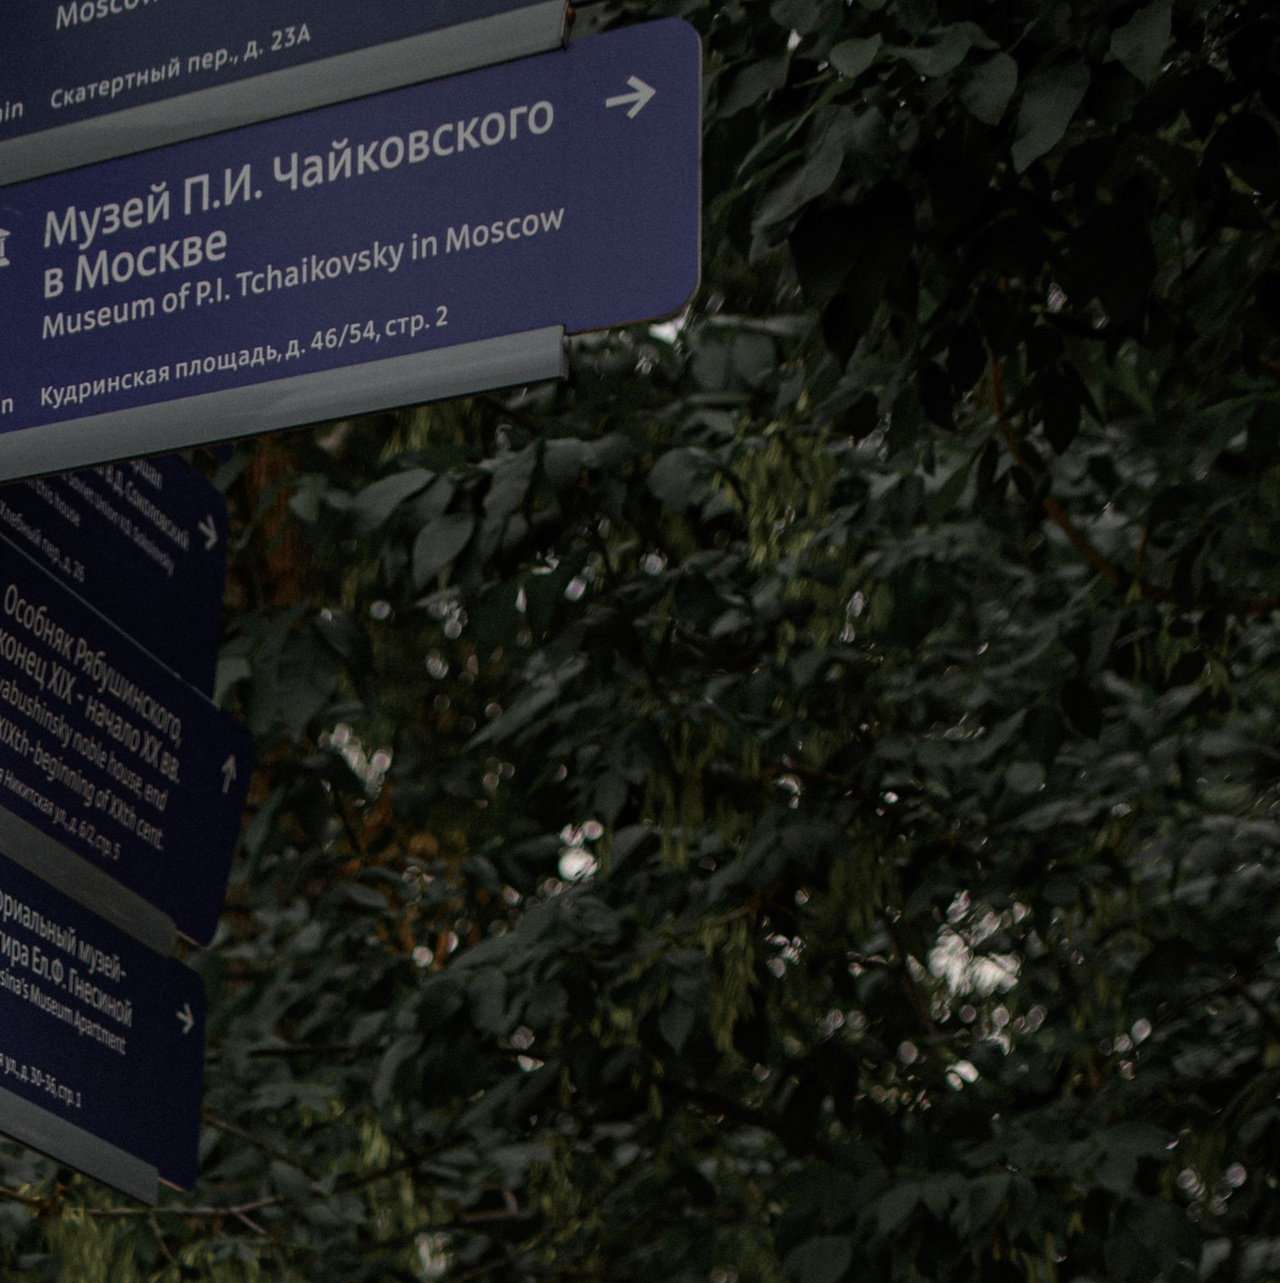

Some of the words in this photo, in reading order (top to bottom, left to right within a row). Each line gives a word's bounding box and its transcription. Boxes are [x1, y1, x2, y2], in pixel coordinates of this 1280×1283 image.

[50, 56, 181, 109] Скатертный
[187, 48, 239, 74] пер.,
[243, 40, 263, 62] д.
[43, 181, 170, 251] Музей
[184, 163, 263, 215] П.И.
[273, 100, 554, 191] Чайковского
[42, 297, 155, 340] Museum
[162, 281, 191, 313] of
[196, 277, 230, 306] P.I.
[235, 240, 405, 297] Tchaikovsky
[411, 232, 437, 260] in
[445, 207, 565, 253] Moscow
[44, 267, 64, 299] в
[75, 230, 227, 292] Москве
[41, 365, 170, 409] Кудринская
[175, 344, 282, 379] площадь,
[285, 339, 306, 361] д.
[310, 320, 381, 351] 46/54,
[385, 314, 430, 338] стр.
[436, 305, 448, 327] 2
[3, 583, 75, 660] Особняк
[73, 637, 182, 749] Рябушинского,
[46, 661, 77, 705] XIX
[85, 695, 141, 752] начало
[71, 731, 108, 769] noble
[29, 983, 73, 1024] Museum
[72, 1010, 127, 1056] Apartment
[68, 967, 133, 1028] Гнесиной
